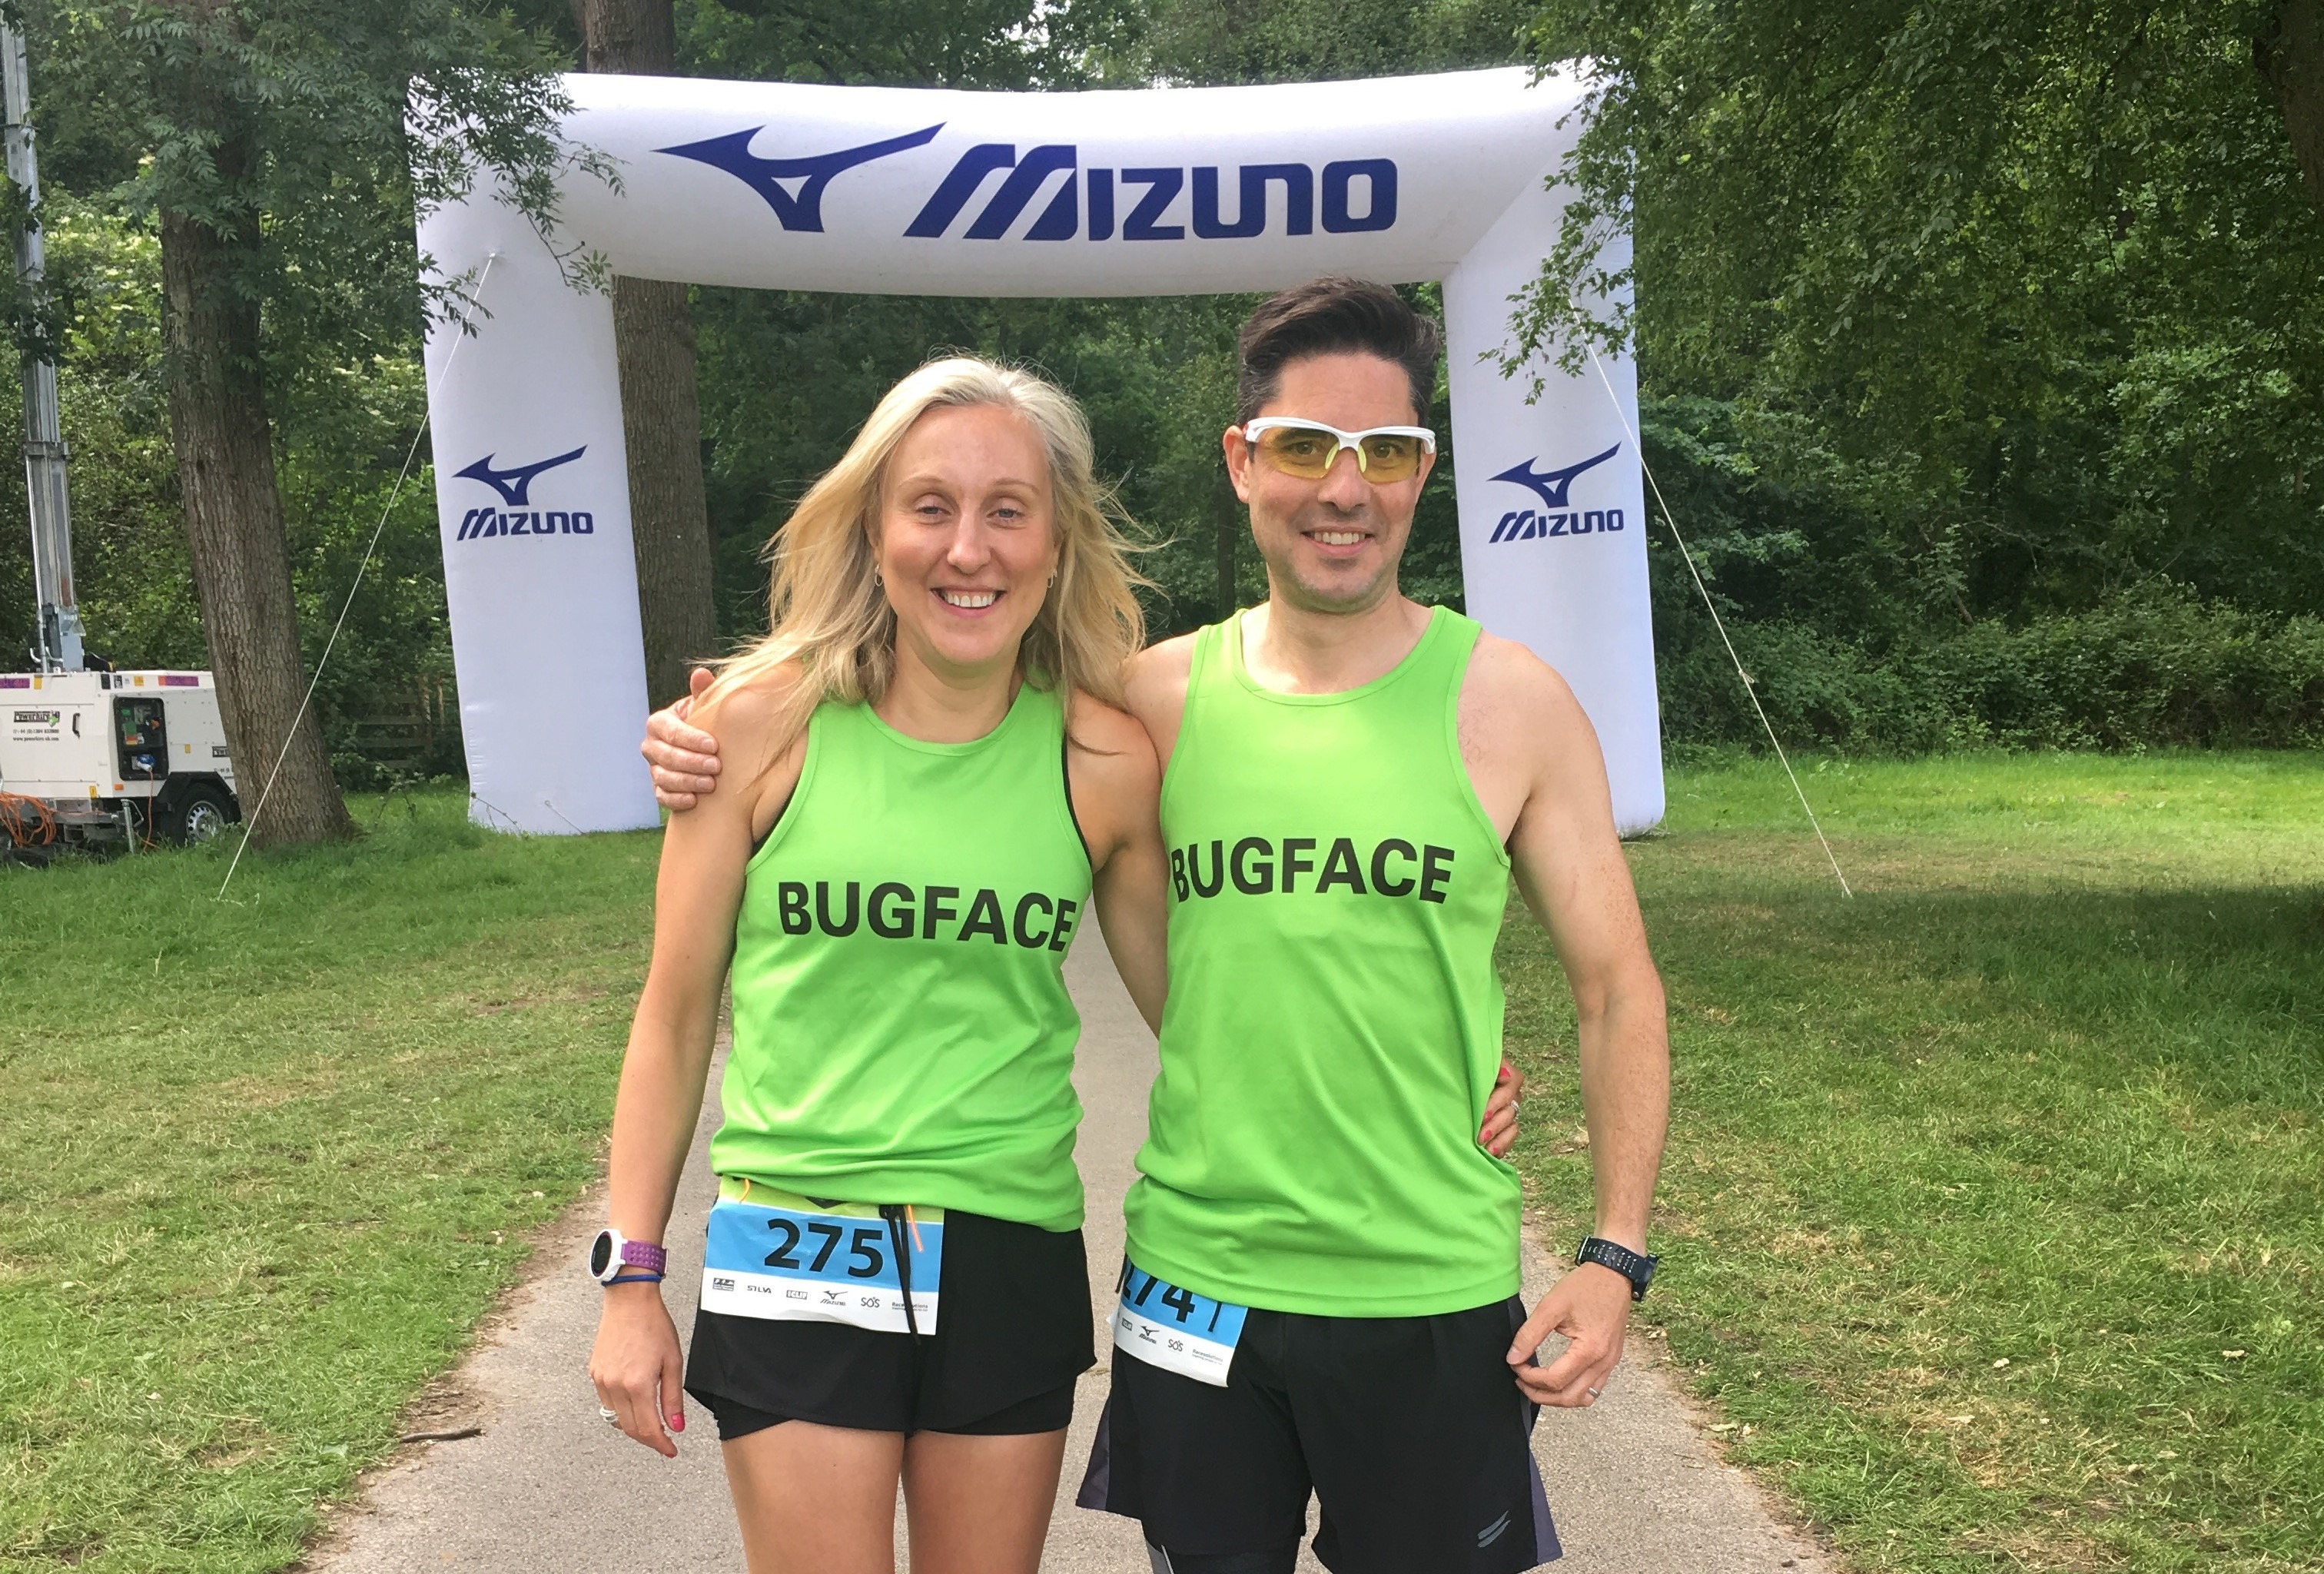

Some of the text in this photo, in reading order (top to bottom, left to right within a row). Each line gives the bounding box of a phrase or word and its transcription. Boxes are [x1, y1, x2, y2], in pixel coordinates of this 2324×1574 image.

[902, 144, 1398, 241] MIZUNO
[457, 507, 593, 541] MIZUNO
[1489, 510, 1624, 543] MIZUNO
[1171, 836, 1455, 904] BUGFACE
[779, 881, 1077, 952] BUGFACE
[765, 1218, 884, 1278] 275
